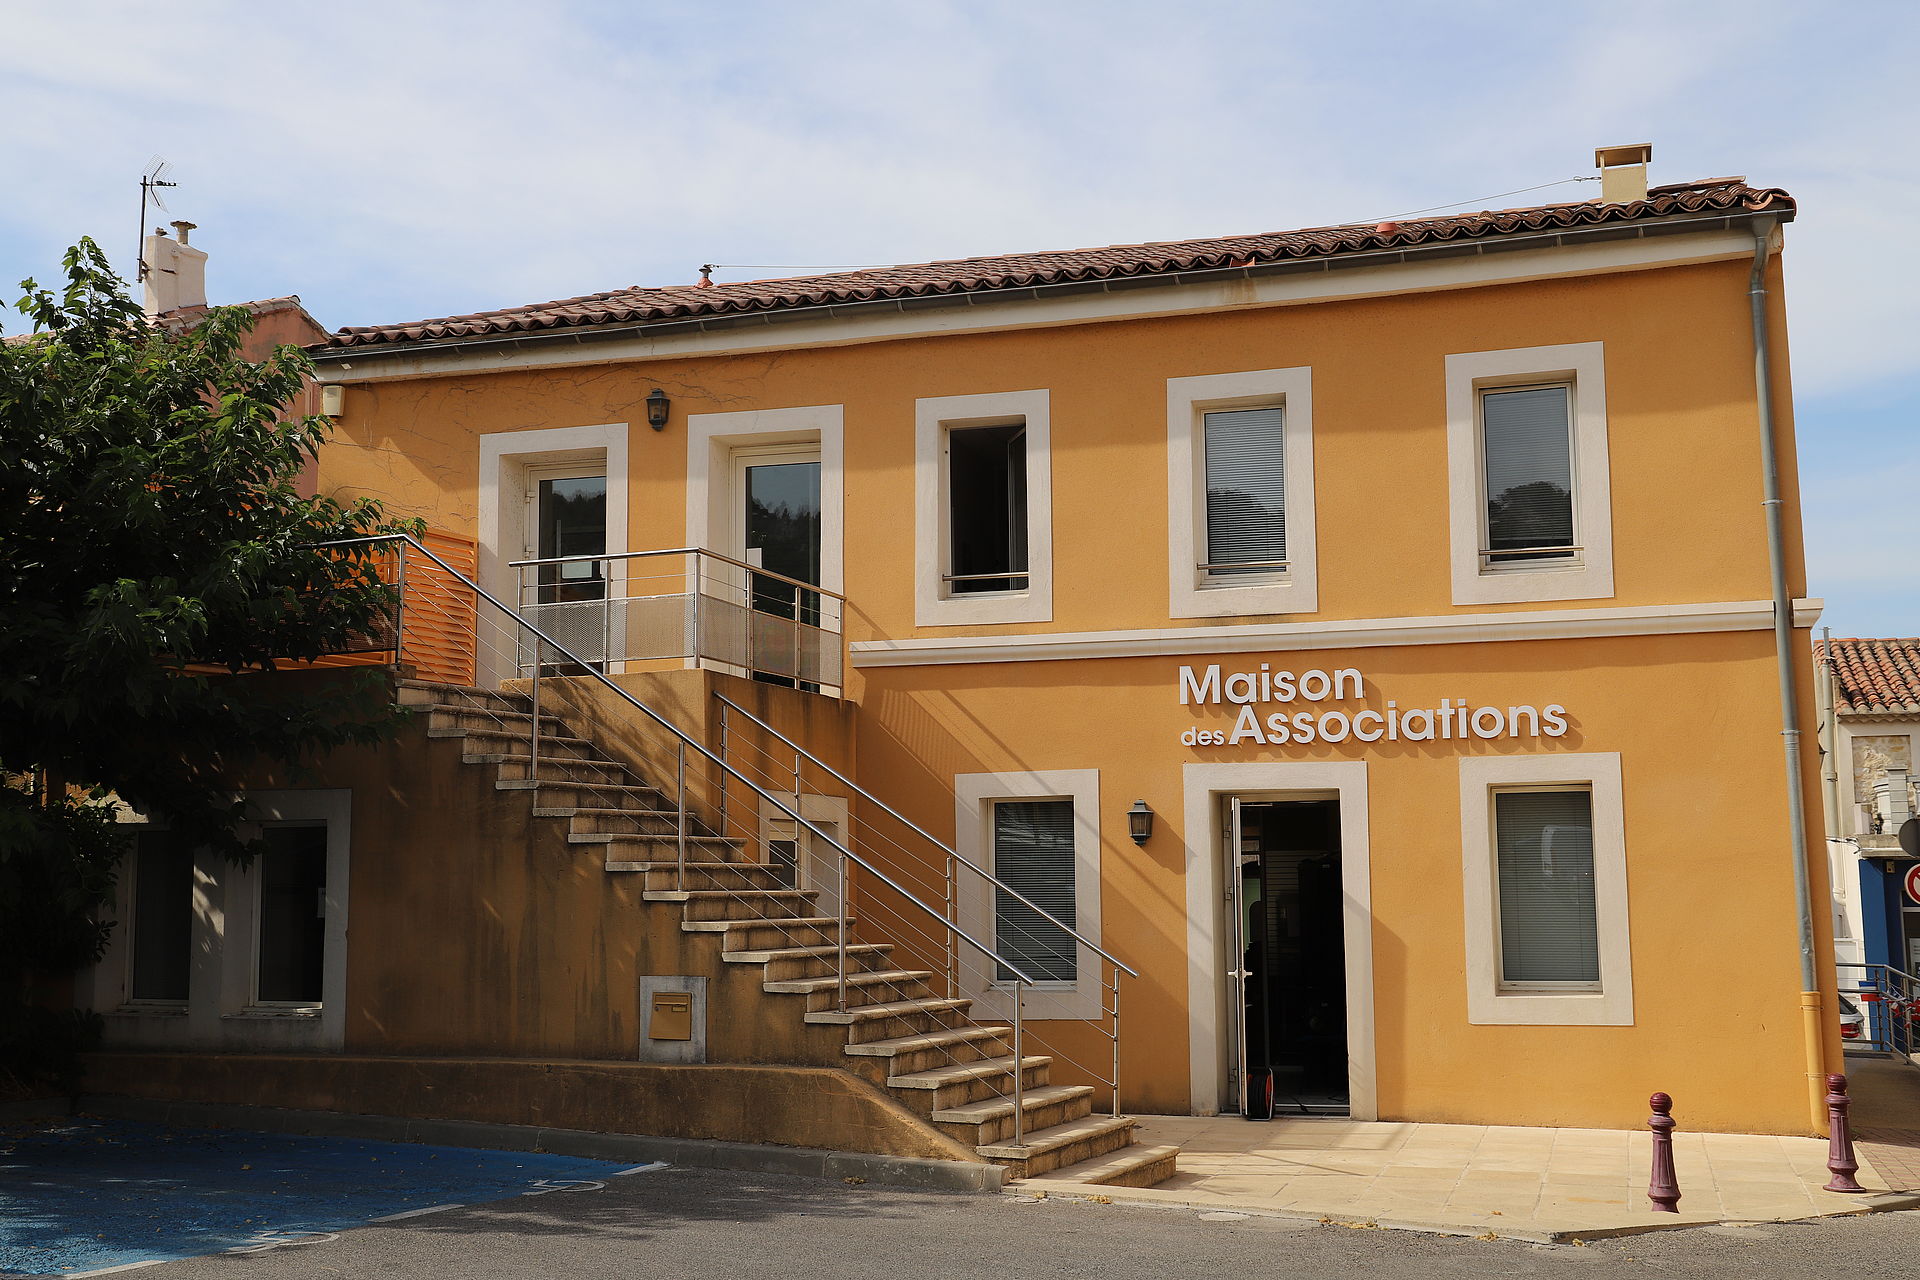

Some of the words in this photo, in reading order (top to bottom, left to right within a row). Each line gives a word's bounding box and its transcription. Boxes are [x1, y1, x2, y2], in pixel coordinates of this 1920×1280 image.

[1179, 663, 1365, 705] Maison
[1180, 726, 1225, 747] des
[1228, 698, 1568, 745] Associations
